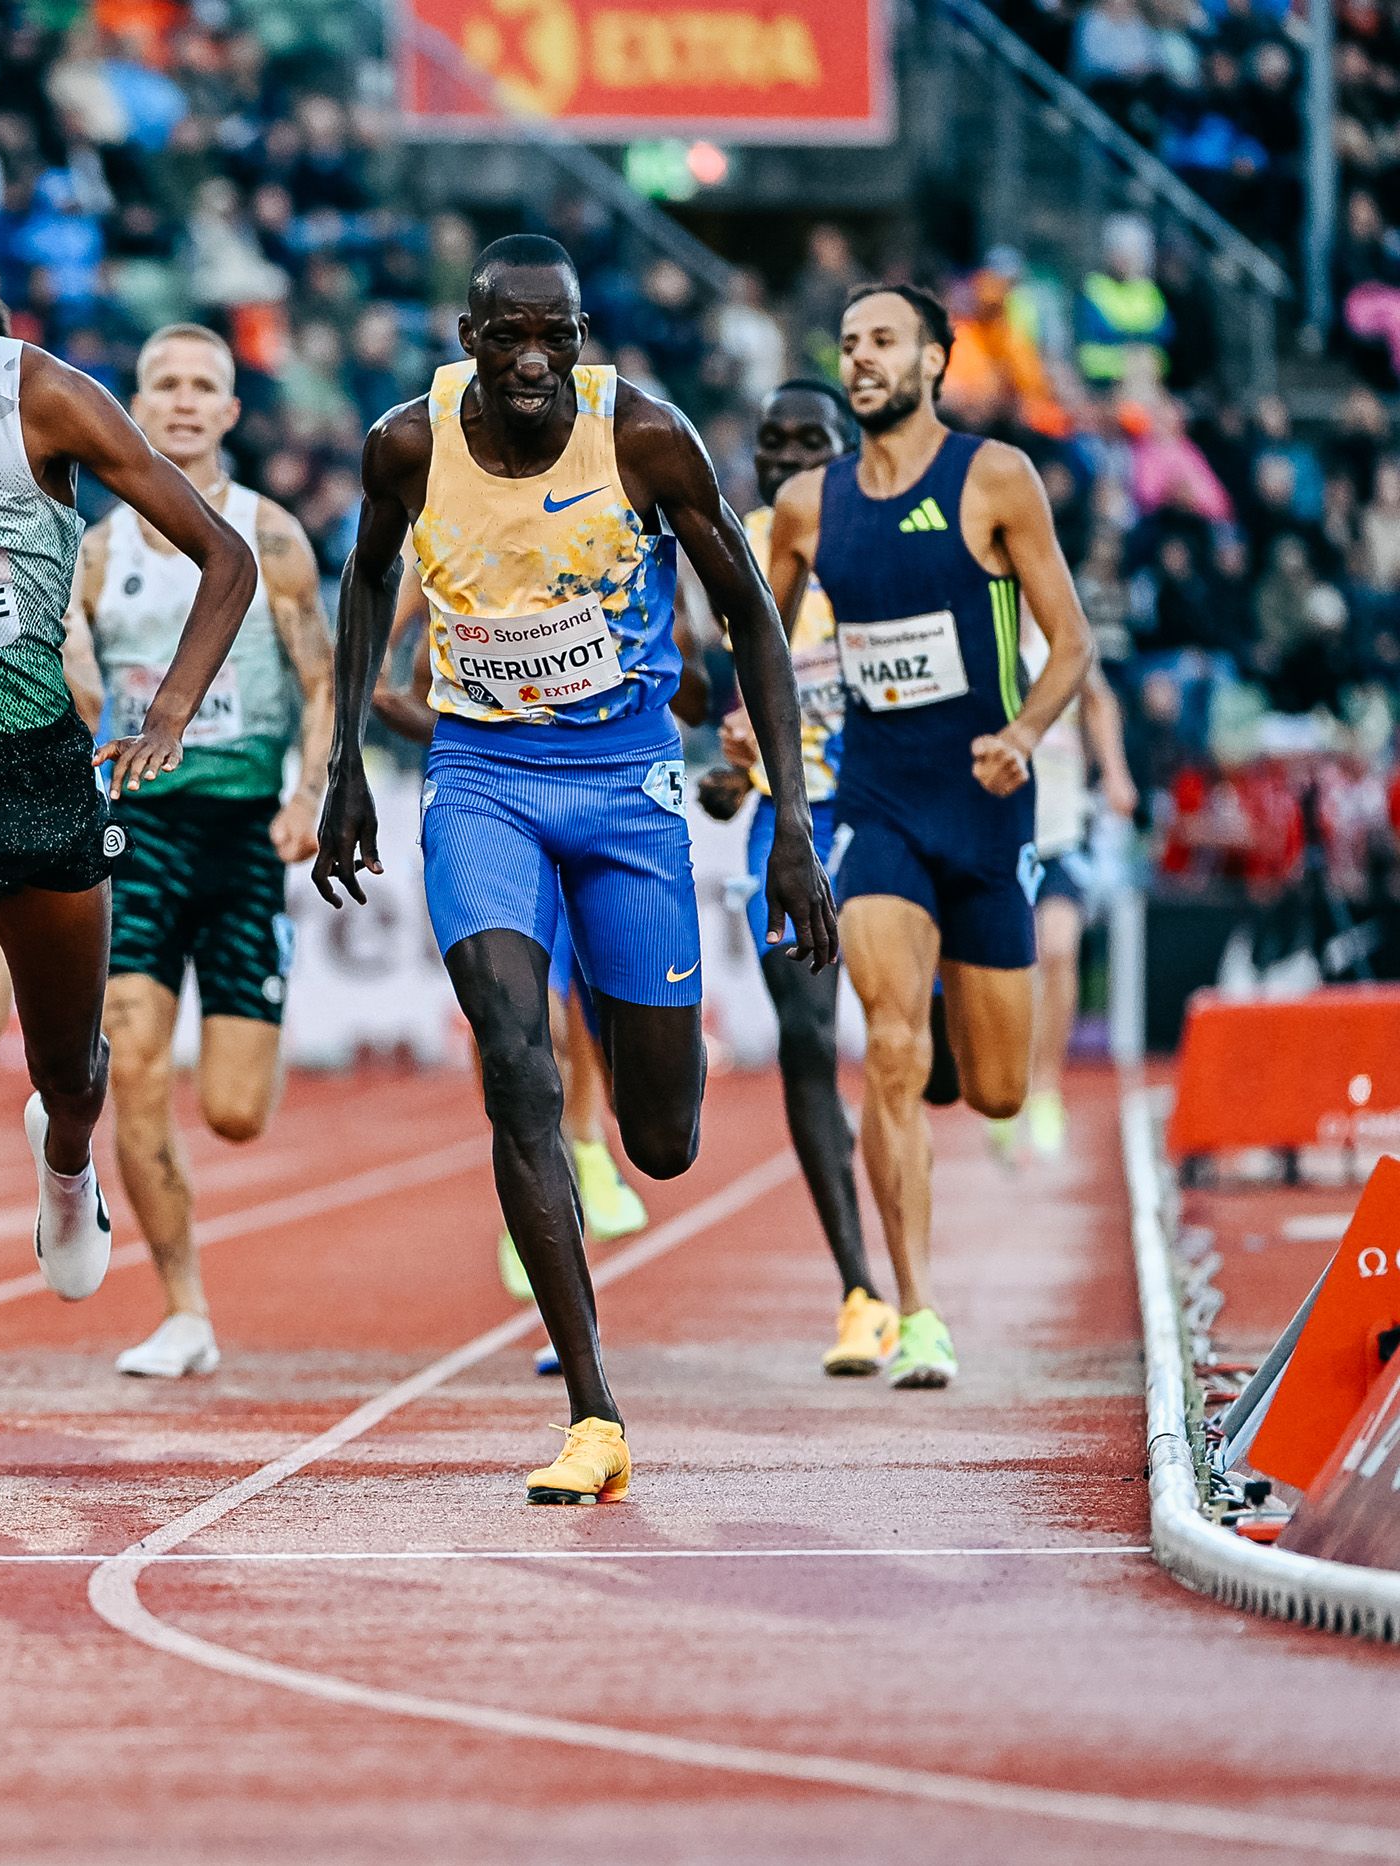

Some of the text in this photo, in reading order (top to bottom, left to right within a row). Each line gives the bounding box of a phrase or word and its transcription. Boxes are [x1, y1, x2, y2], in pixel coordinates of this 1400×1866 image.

[494, 608, 592, 643] Storebrand
[459, 637, 605, 681] CHERUIYOT
[860, 655, 934, 684] HABZ
[544, 678, 592, 698] EXTRA
